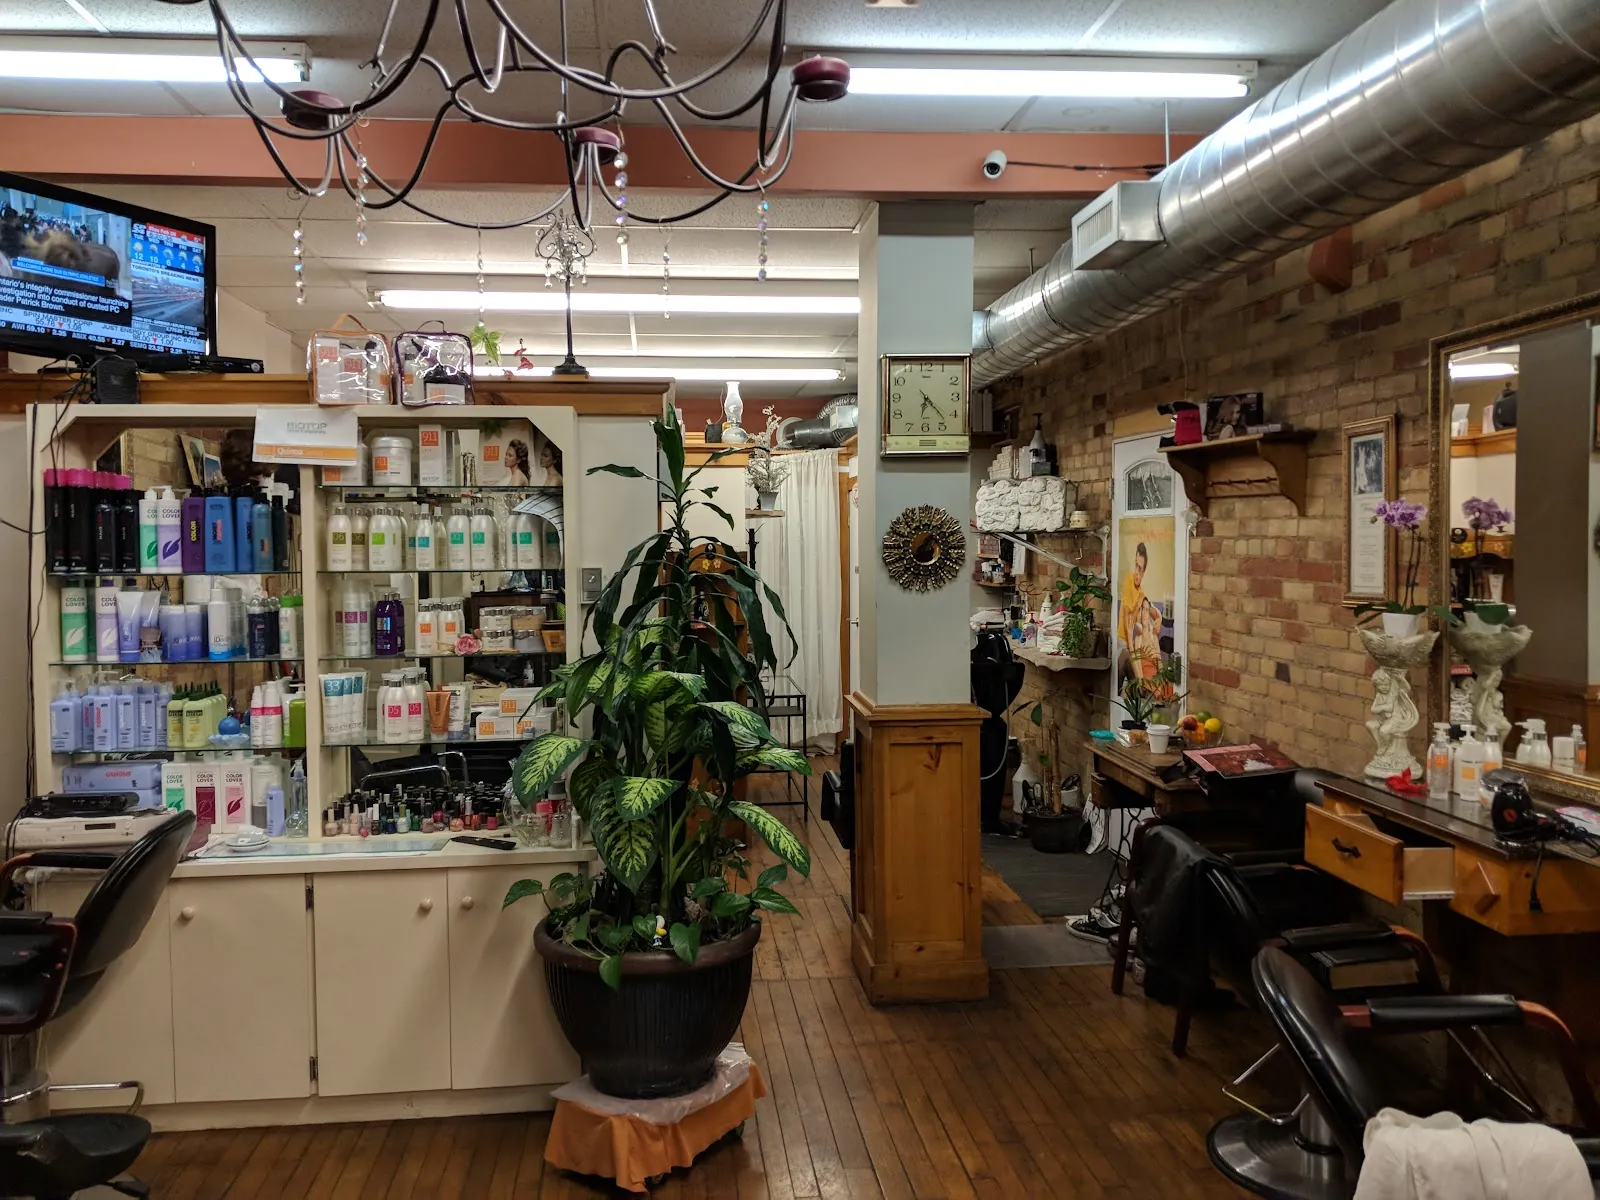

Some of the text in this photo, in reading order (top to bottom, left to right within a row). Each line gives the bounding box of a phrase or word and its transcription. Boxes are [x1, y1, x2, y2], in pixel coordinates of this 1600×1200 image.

[134, 252, 144, 260] 12
[149, 255, 159, 263] 10
[194, 265, 200, 273] 3
[25, 282, 53, 294] integrity
[53, 288, 99, 301] commissioner
[98, 295, 129, 309] launching
[15, 296, 40, 307] Patrick
[41, 301, 65, 312] Brown.
[37, 291, 51, 301] into
[51, 295, 79, 306] conduct
[87, 302, 109, 312] ousted
[109, 306, 120, 314] PC
[23, 311, 40, 319] SPIN
[42, 314, 72, 324] MASTER
[73, 319, 93, 327] CORP
[101, 324, 118, 332] JUST
[147, 331, 170, 339] GROUP
[159, 338, 174, 346] 1.00
[904, 363, 913, 373] 11
[920, 362, 933, 372] 12
[941, 363, 945, 373] 1
[894, 376, 906, 386] 10
[949, 376, 959, 386] 2
[892, 393, 902, 403] 9
[951, 392, 960, 402] 3
[893, 409, 903, 419] 8
[949, 409, 958, 419] 4
[286, 421, 328, 430] BIOTOP
[905, 422, 914, 432] 7
[921, 422, 930, 432] 6
[938, 421, 947, 431] 5
[421, 431, 438, 442] 911
[484, 446, 499, 456] 911
[333, 532, 346, 541] 06
[325, 680, 340, 692] 33
[409, 702, 420, 713] 05
[502, 700, 516, 710] 911
[480, 722, 495, 732] 911
